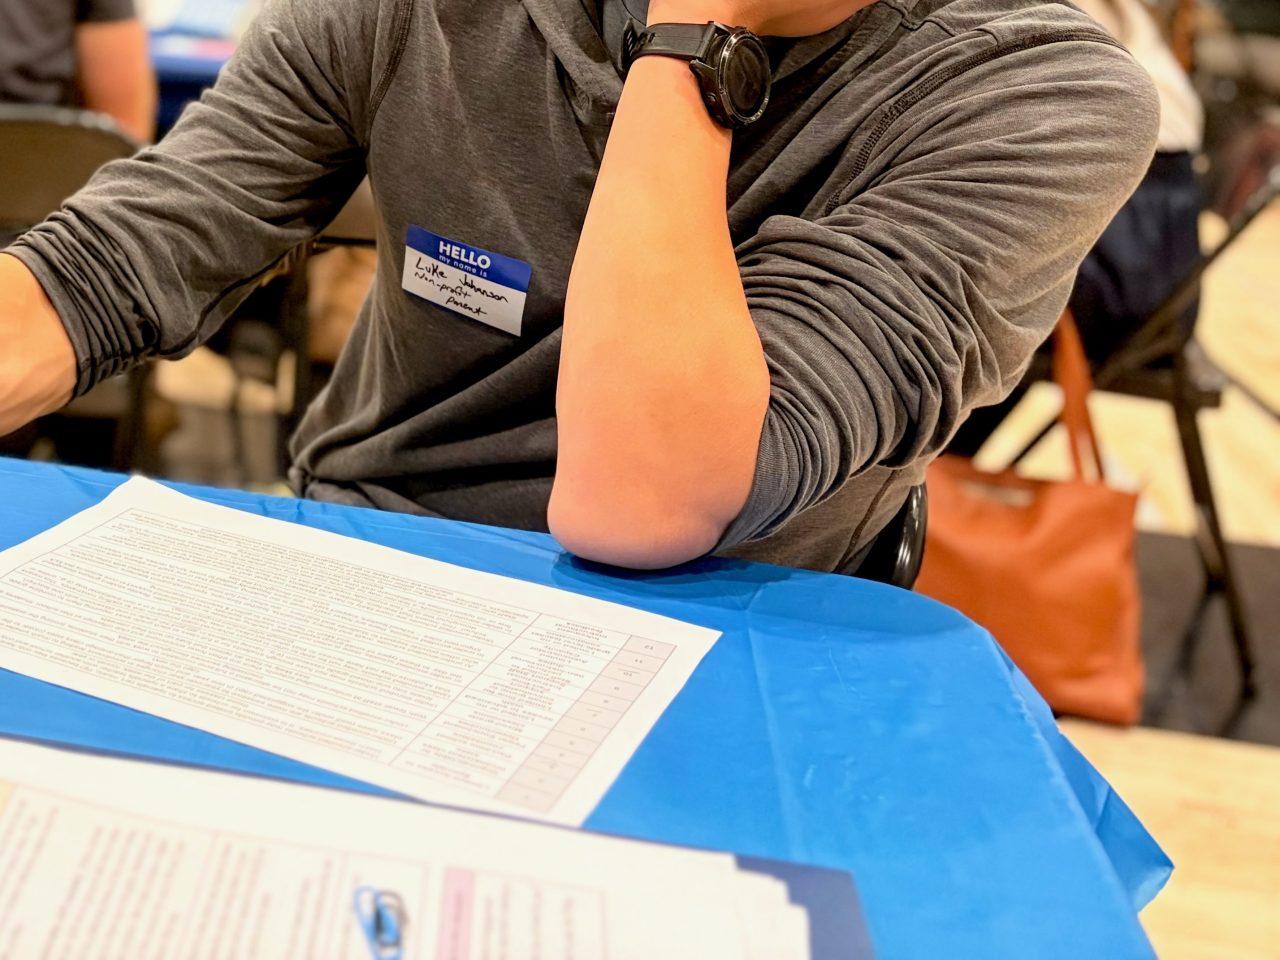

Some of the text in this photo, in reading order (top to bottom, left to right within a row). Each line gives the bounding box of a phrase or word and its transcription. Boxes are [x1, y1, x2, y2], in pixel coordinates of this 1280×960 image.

[439, 241, 491, 269] HELLO
[439, 256, 450, 265] my
[453, 261, 476, 273] name
